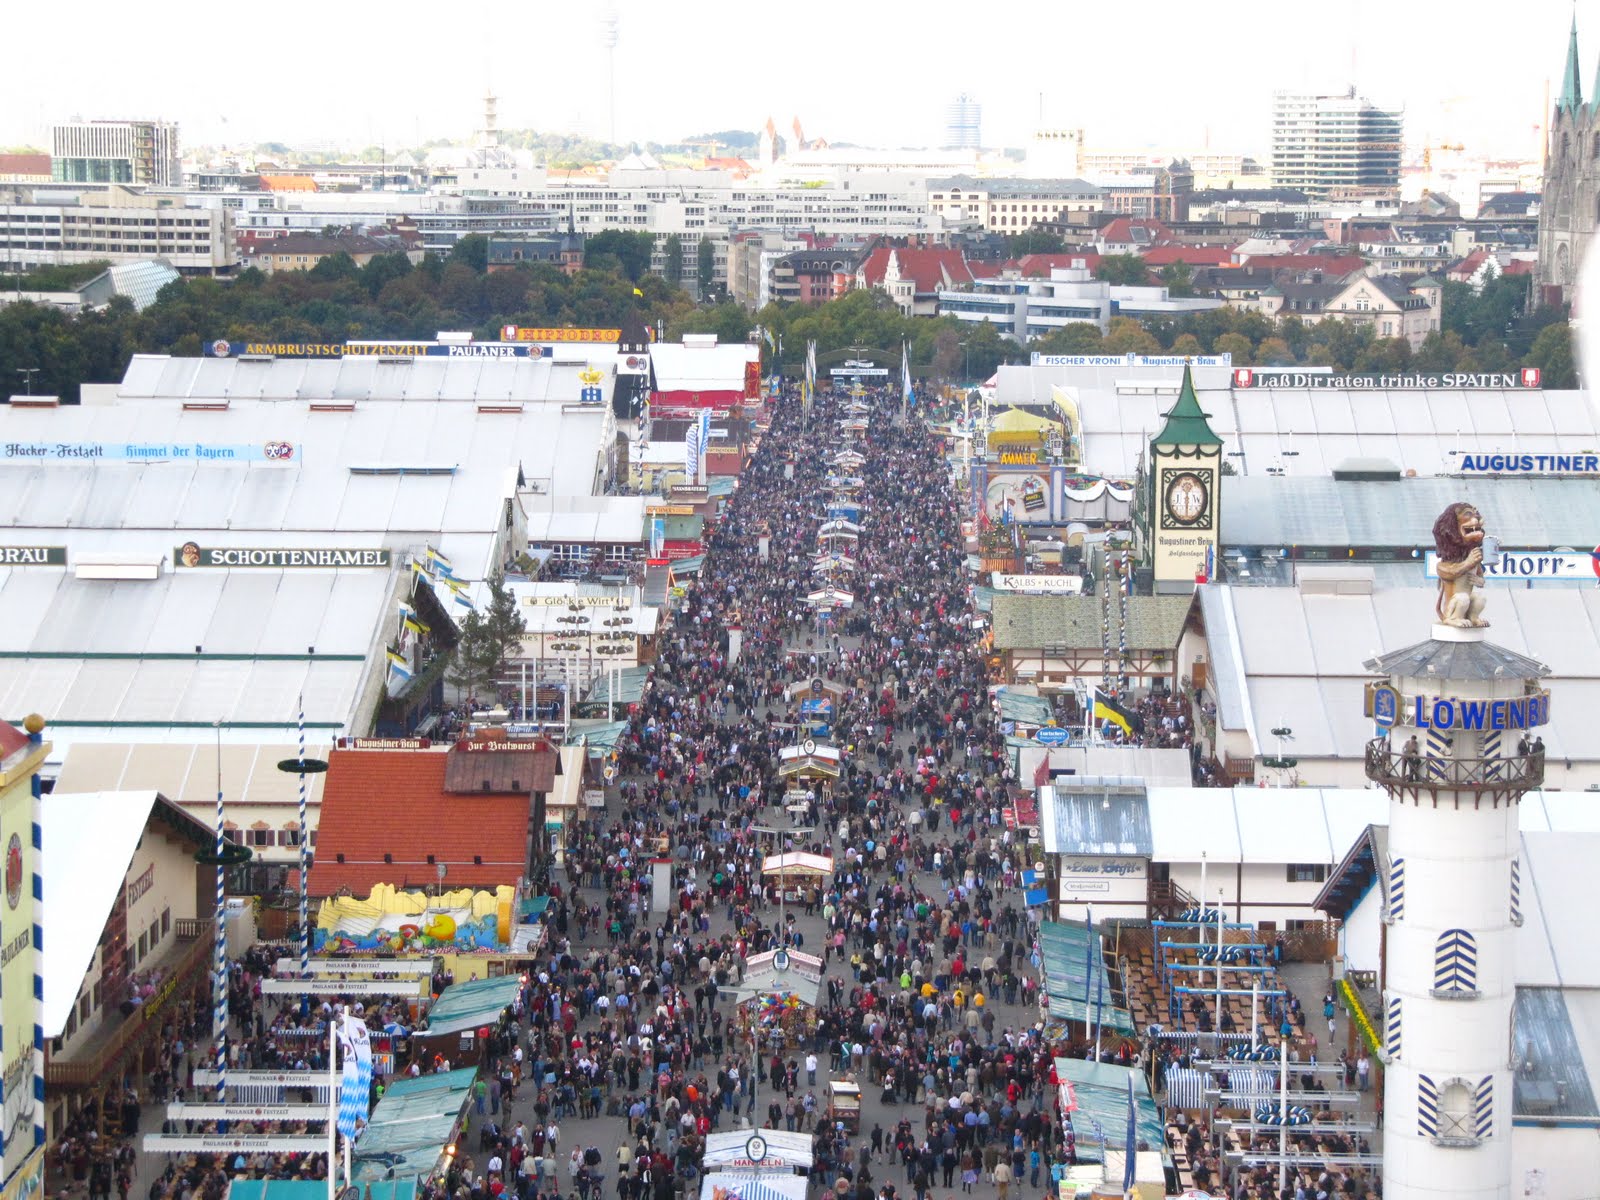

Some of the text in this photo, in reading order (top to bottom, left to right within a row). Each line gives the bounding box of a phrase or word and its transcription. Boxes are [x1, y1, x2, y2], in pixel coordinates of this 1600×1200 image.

[523, 329, 621, 341] HIPPODRO
[449, 346, 515, 356] PAULANER
[1046, 357, 1121, 365] FISCHER VRONI
[1142, 355, 1216, 366] Augustinr Bräu
[1258, 374, 1290, 388] Laß
[1294, 374, 1322, 388] Dir
[1380, 374, 1437, 388] trinke
[1442, 373, 1516, 388] SPATEN
[6, 444, 48, 457] Hacker
[126, 445, 234, 460] Himmel der Bayern
[1000, 453, 1037, 465] AMMER
[1461, 455, 1598, 471] AUGUSTINER
[1159, 537, 1196, 547] Augustiner
[211, 550, 387, 565] SCHOTTENHAMEL
[1003, 577, 1036, 589] KALBS
[545, 597, 584, 606] Glöke
[467, 741, 536, 751] Zur Bratwurst
[734, 1159, 782, 1167] MANELN
